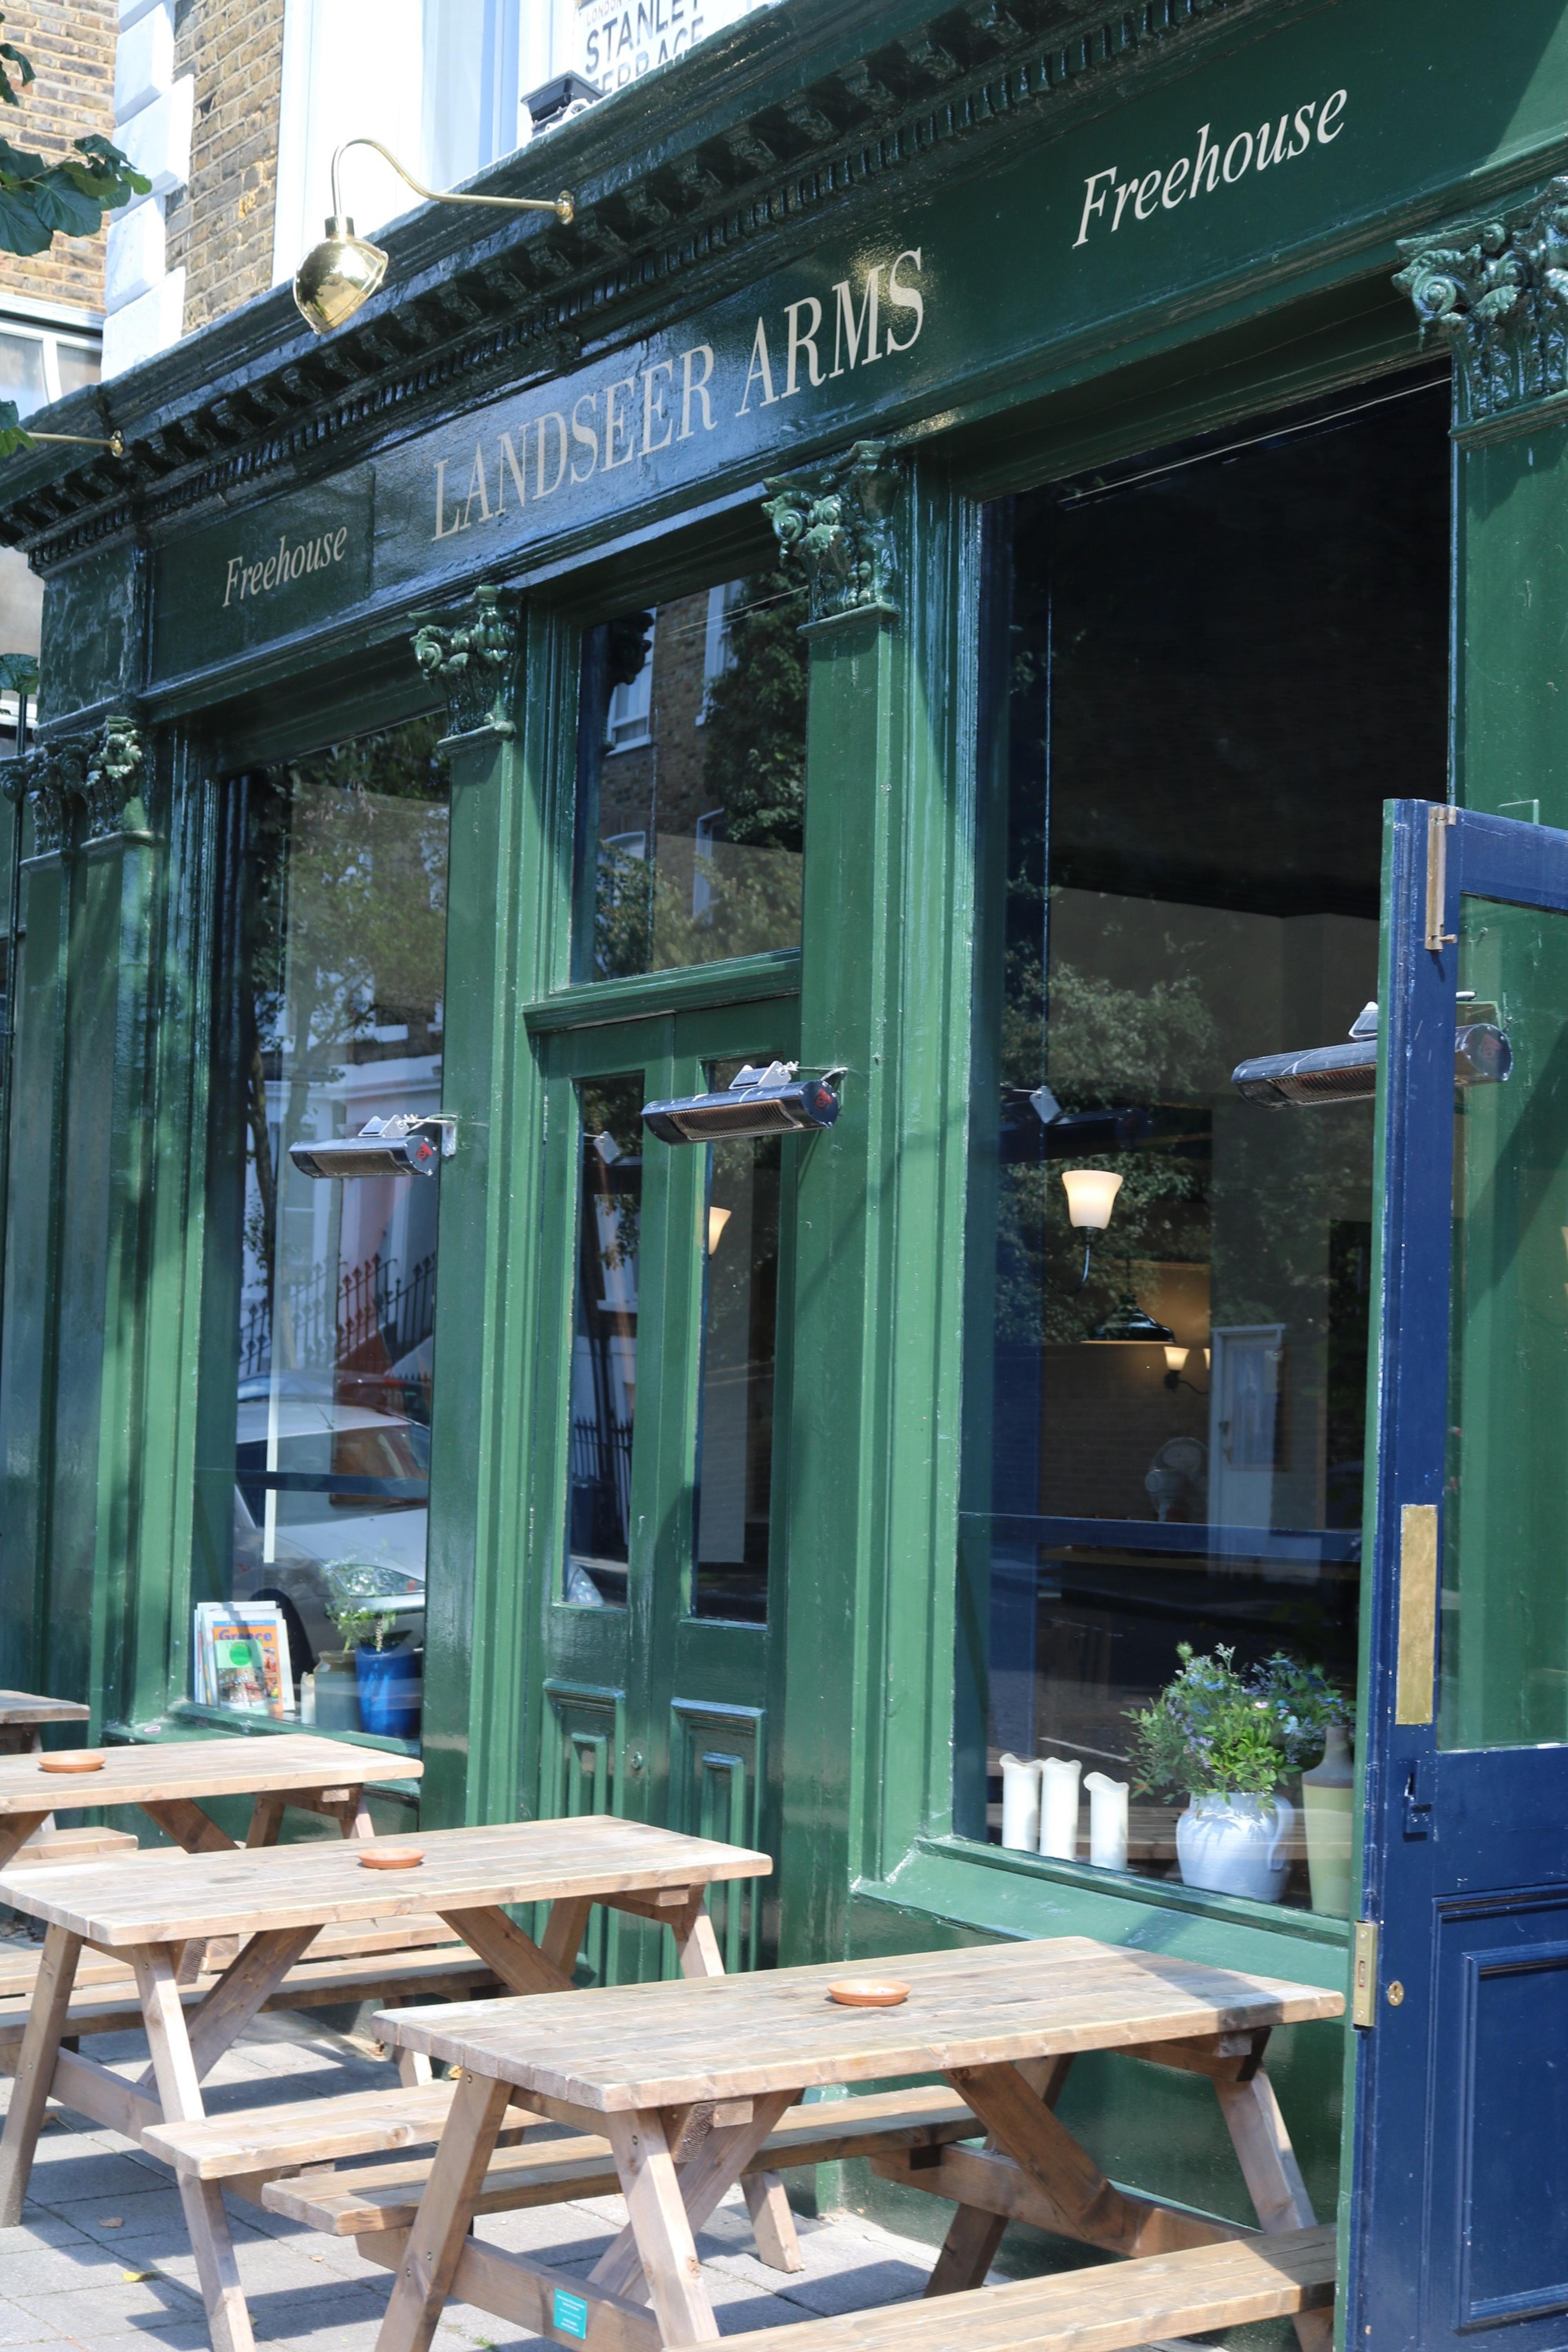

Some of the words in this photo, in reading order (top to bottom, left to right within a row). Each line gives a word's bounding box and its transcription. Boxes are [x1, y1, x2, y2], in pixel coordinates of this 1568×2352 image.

[585, 0, 697, 74] STANLE
[590, 16, 704, 95] ERRACE
[1072, 89, 1348, 248] Freehouse
[431, 345, 718, 541] LANDSEER
[735, 247, 924, 417] ARMS
[222, 526, 347, 607] Freehouse
